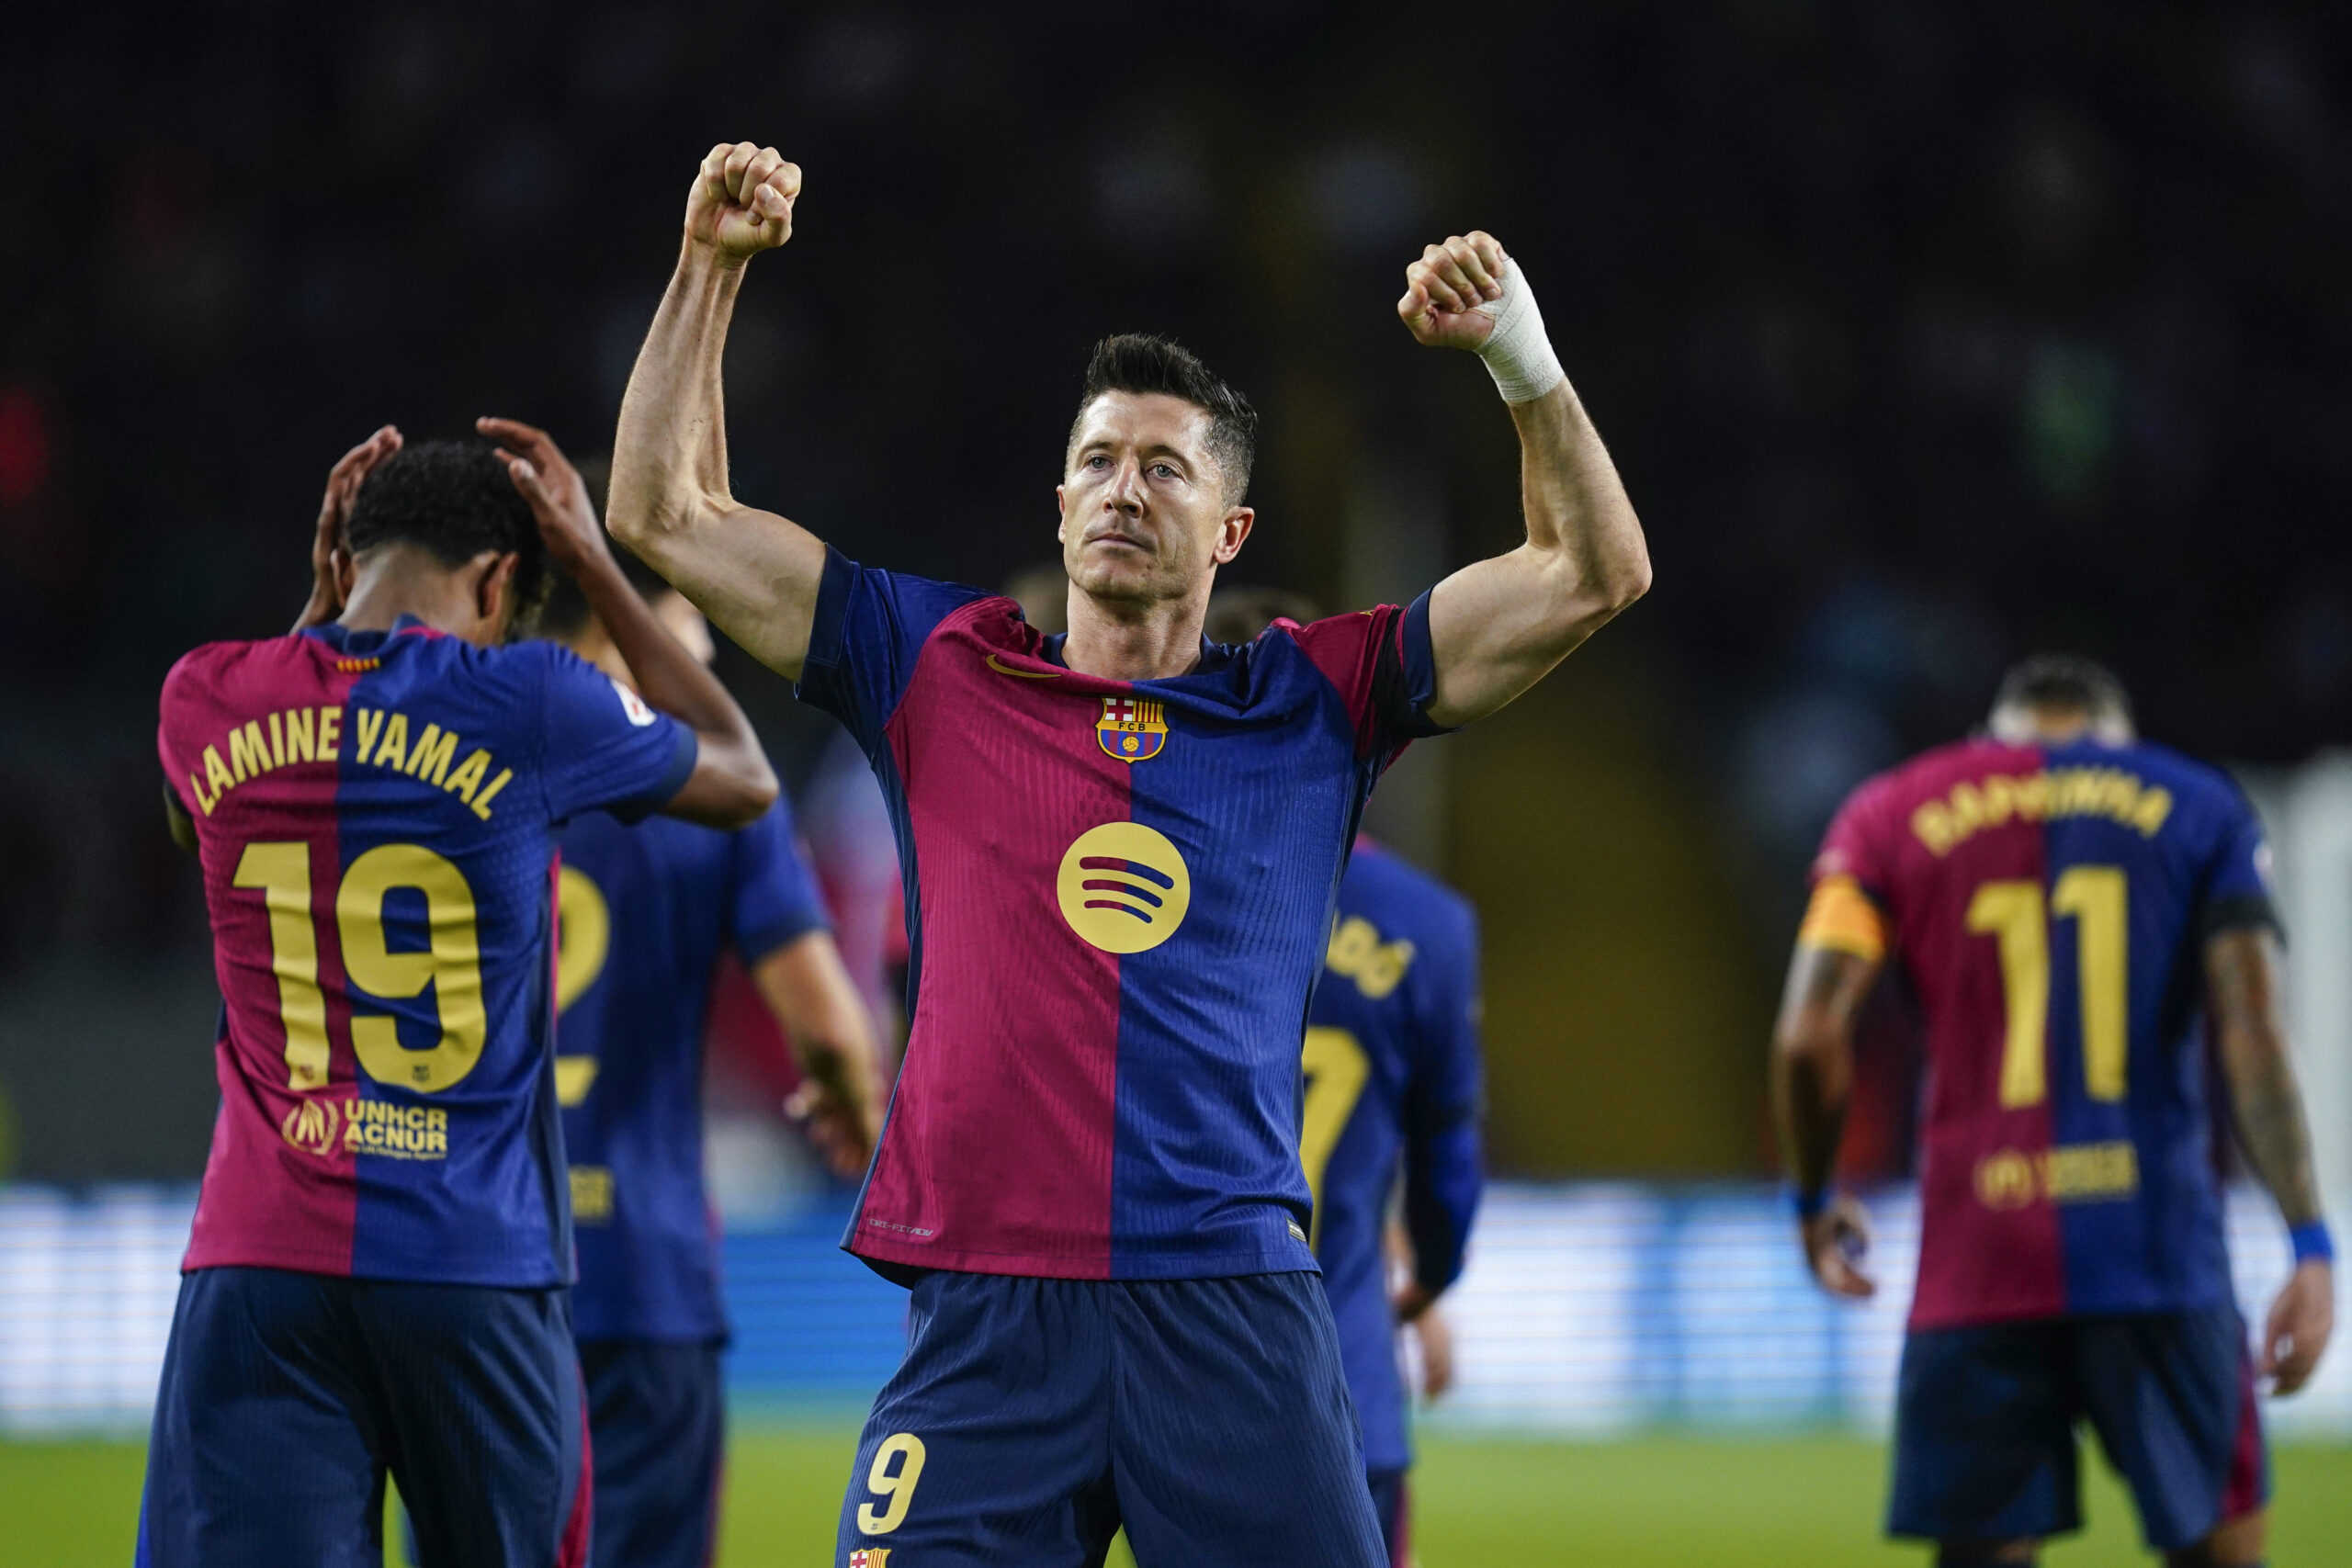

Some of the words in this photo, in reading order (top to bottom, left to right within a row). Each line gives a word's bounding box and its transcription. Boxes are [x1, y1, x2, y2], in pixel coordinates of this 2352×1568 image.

[189, 705, 343, 818] LAMINE
[356, 707, 514, 822] YAMAL
[1118, 722, 1146, 731] FCB
[232, 841, 487, 1093] 19
[1964, 864, 2130, 1111] 11
[343, 1121, 447, 1151] ACNUR
[344, 1099, 447, 1132] UNHCR
[857, 1433, 926, 1535] 9
